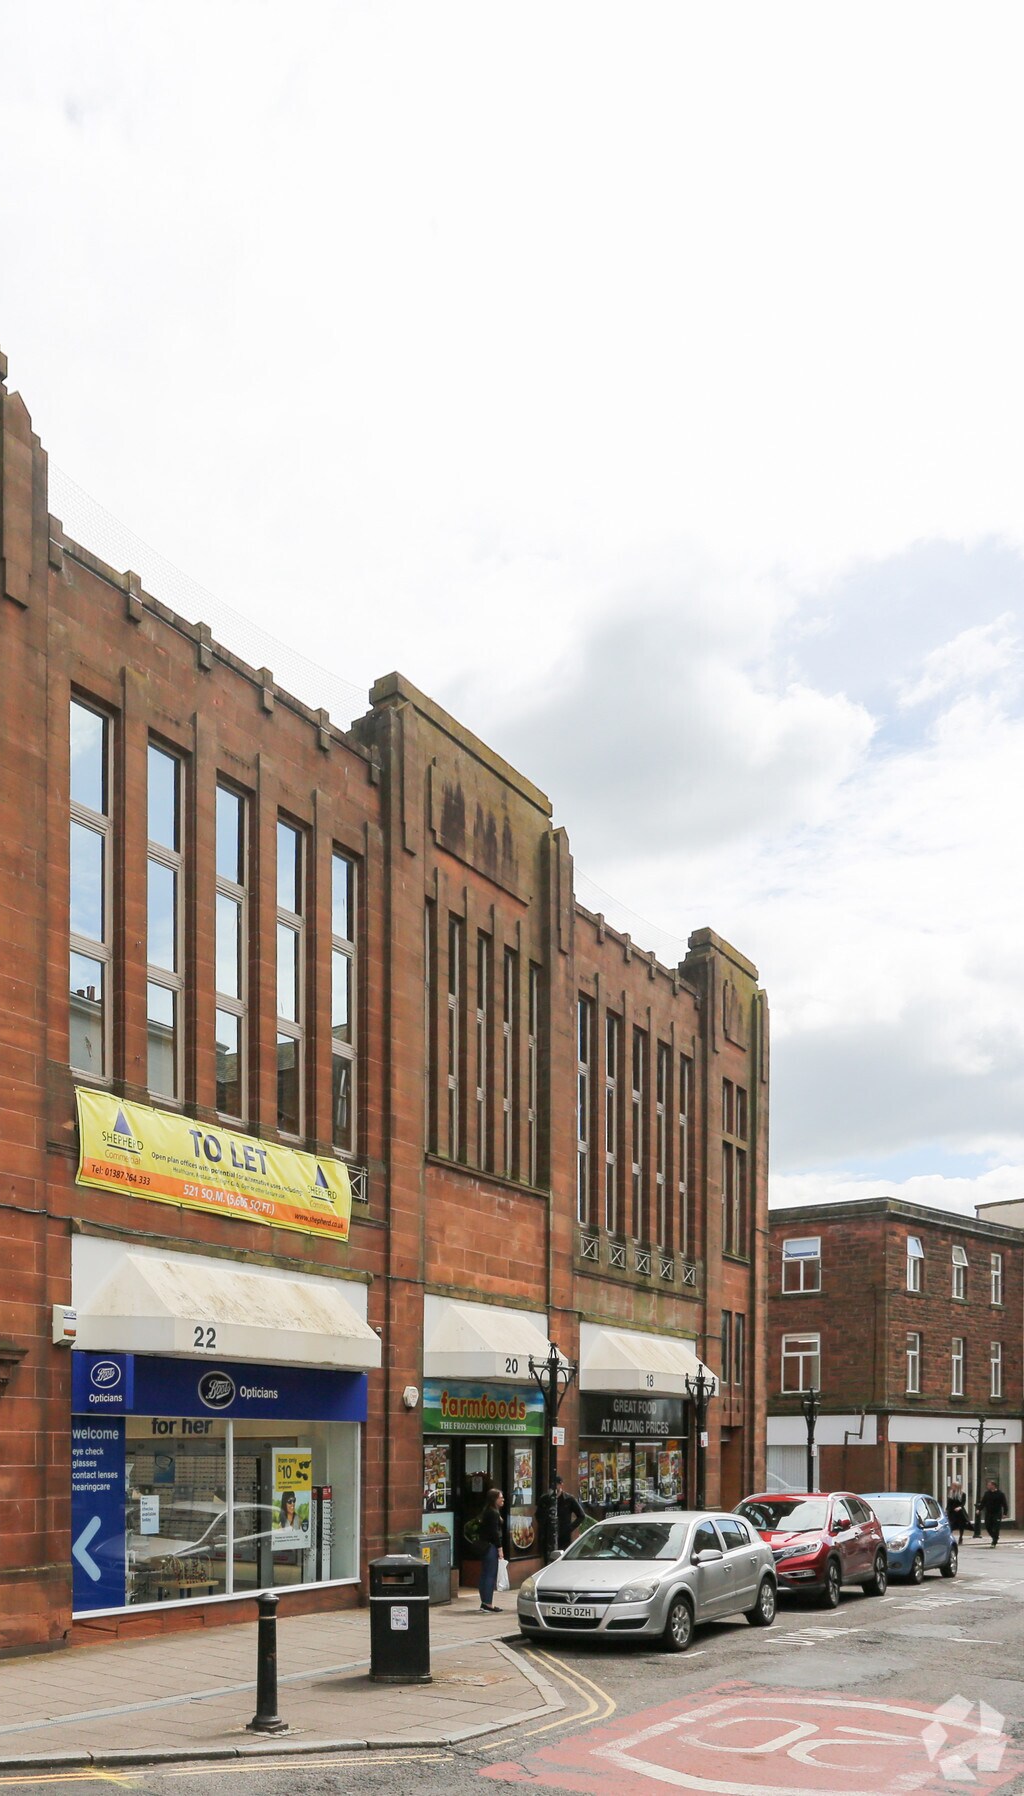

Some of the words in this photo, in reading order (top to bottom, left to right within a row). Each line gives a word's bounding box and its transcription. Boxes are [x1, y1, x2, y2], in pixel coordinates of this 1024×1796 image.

[189, 1128, 222, 1163] TO
[230, 1141, 267, 1175] LET
[151, 1151, 166, 1161] Open
[167, 1156, 179, 1165] plan
[180, 1159, 197, 1169] offices
[92, 1164, 104, 1174] Tel:
[104, 1168, 124, 1180] 01387
[138, 1175, 151, 1186] 333
[183, 1184, 199, 1196] 521
[201, 1188, 225, 1203] SQ.M.
[249, 1199, 275, 1216] SQ.FT.)
[294, 1213, 344, 1229] www.shepherd.co.uk
[193, 1326, 217, 1349] 22
[505, 1357, 519, 1375] 20
[95, 1367, 116, 1382] Boots
[646, 1374, 654, 1388] 18
[206, 1380, 232, 1400] Boots
[240, 1386, 278, 1399] Opticians
[89, 1393, 123, 1404] Opticians
[441, 1390, 526, 1420] farmfoods
[613, 1399, 636, 1413] GREAT
[638, 1400, 657, 1415] FOOD
[72, 1426, 119, 1440] welcome
[152, 1418, 176, 1435] for
[182, 1418, 213, 1435] her
[440, 1421, 452, 1430] THE
[454, 1422, 477, 1430] FROZEN
[478, 1422, 494, 1431] FOOD
[494, 1423, 527, 1432] SPECIALISTS
[601, 1419, 610, 1433] AT
[612, 1420, 644, 1434] AMAZING
[646, 1421, 670, 1435] PRICES
[72, 1449, 84, 1457] eye
[85, 1448, 104, 1456] check
[72, 1459, 97, 1469] glasses
[72, 1472, 97, 1480] contact
[98, 1470, 118, 1479] lenses
[72, 1482, 111, 1493] hearingcare
[551, 1606, 572, 1616] SJ05
[574, 1608, 591, 1617] OZH
